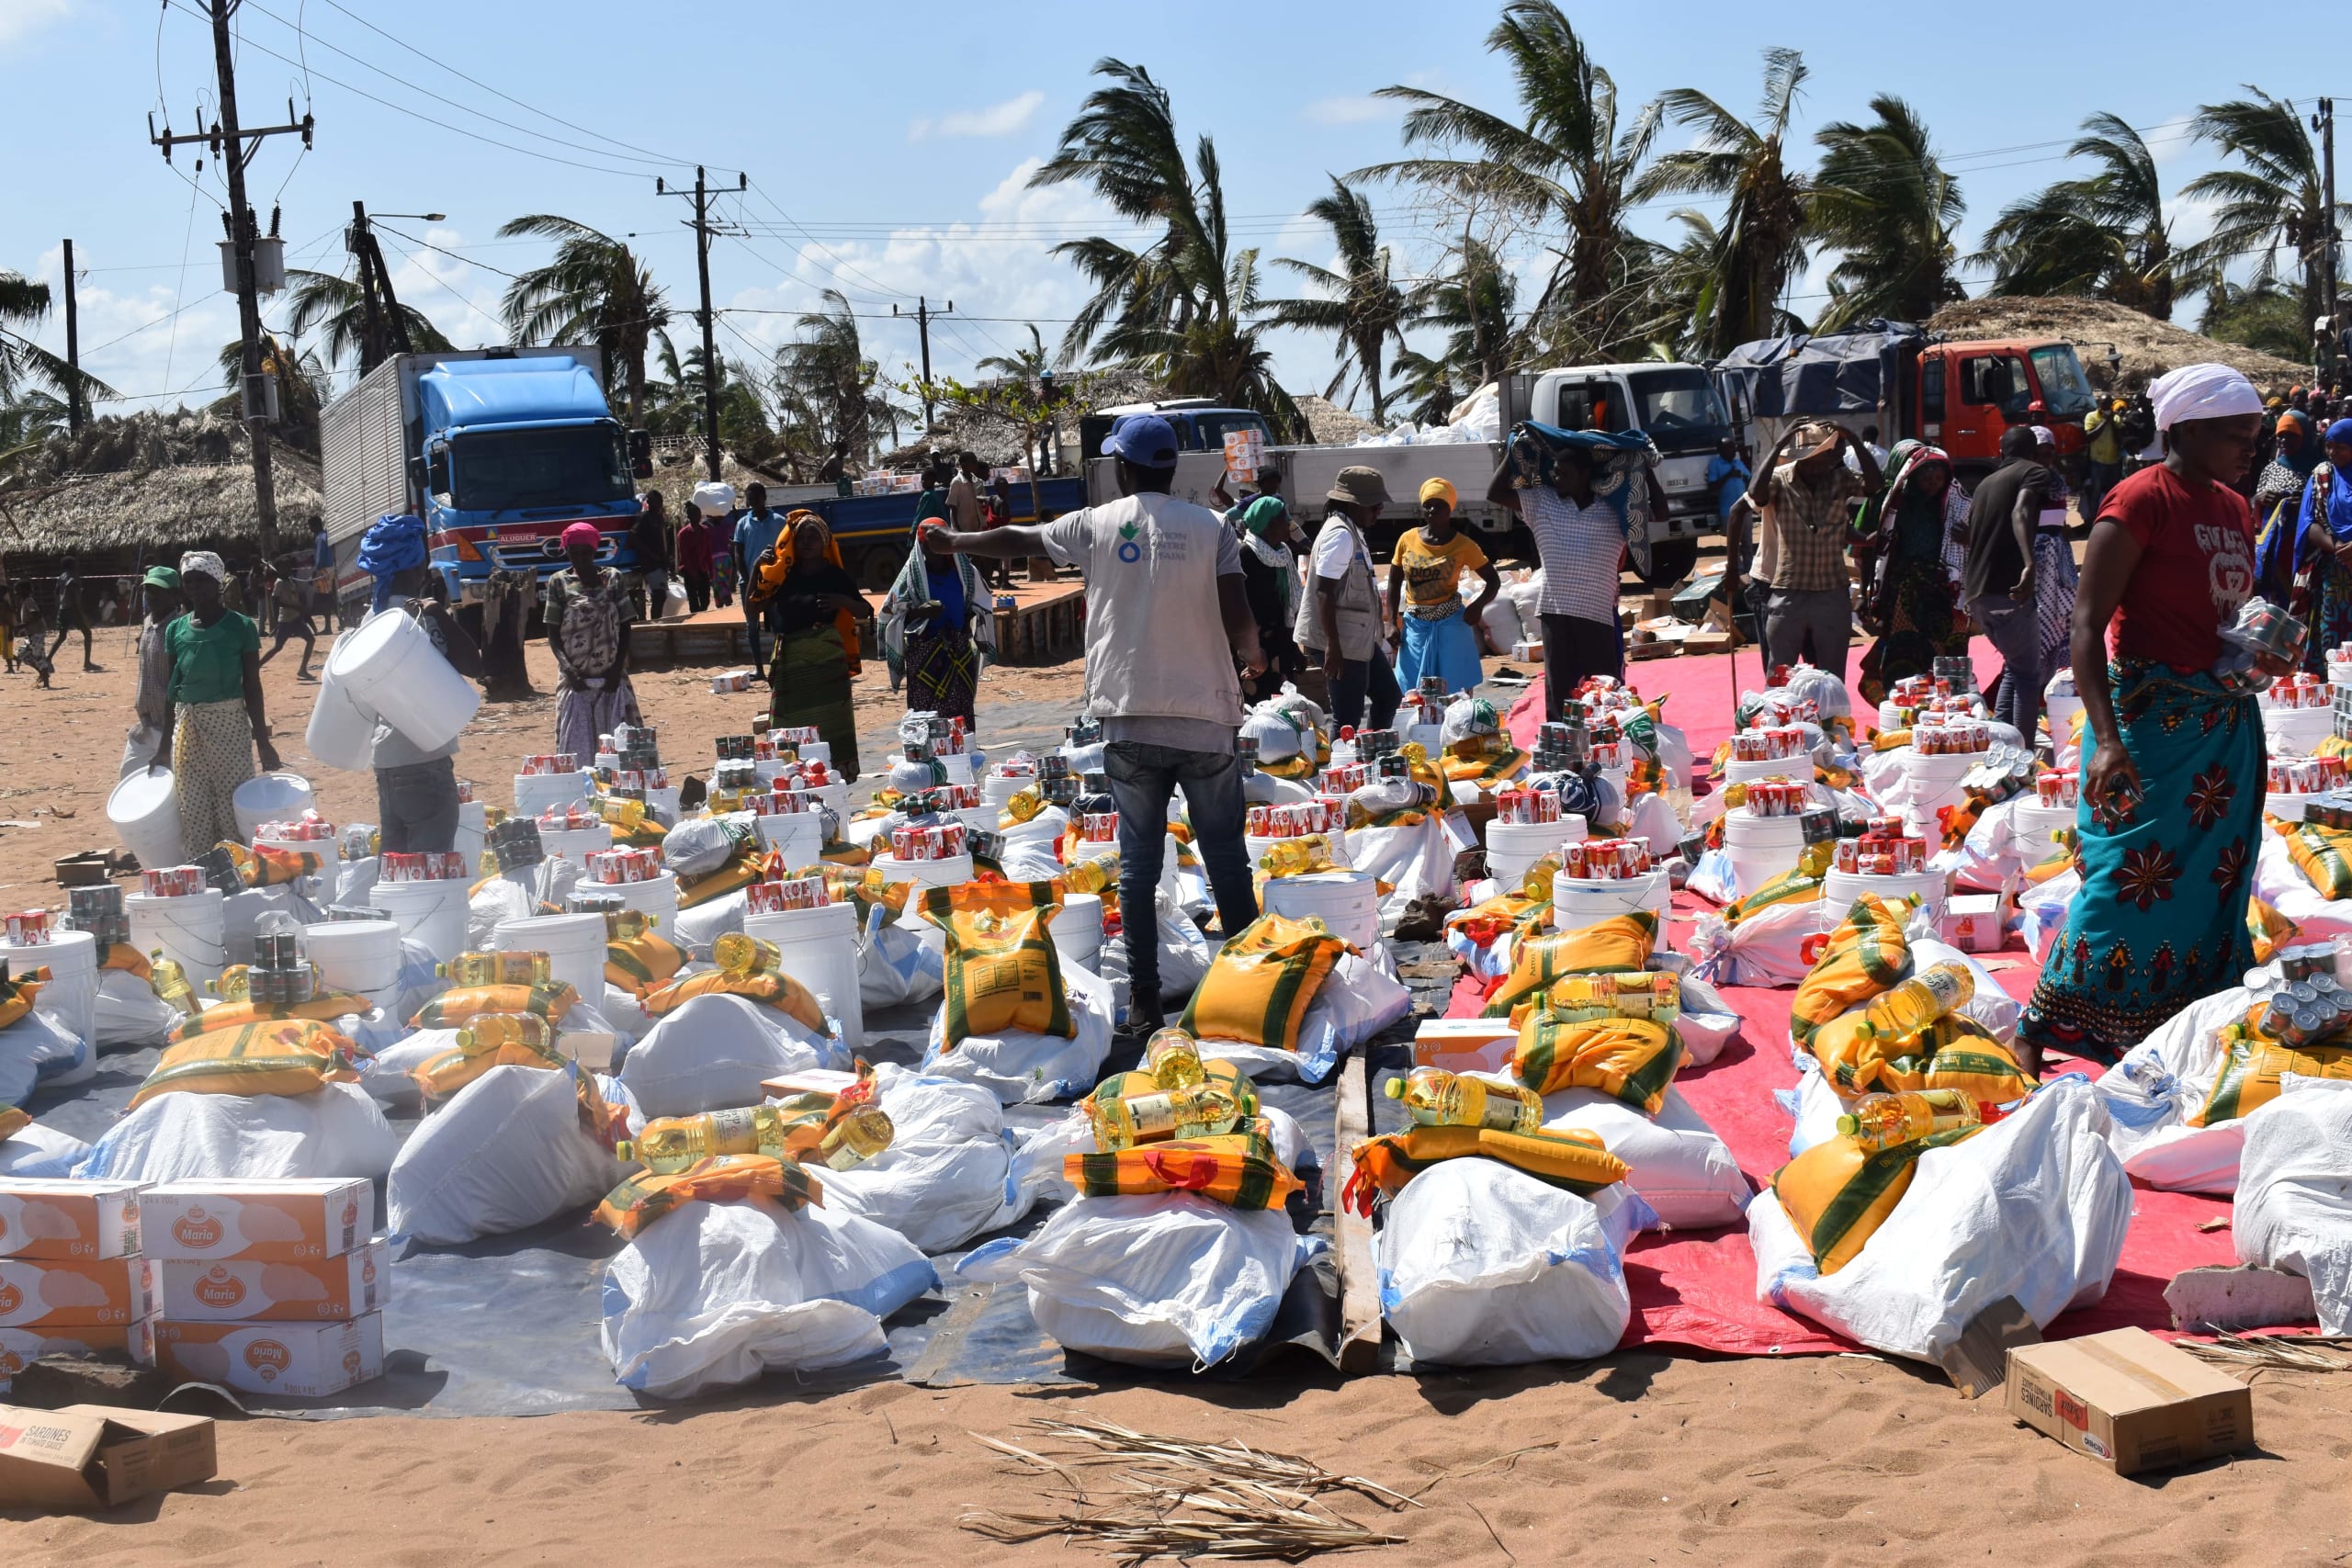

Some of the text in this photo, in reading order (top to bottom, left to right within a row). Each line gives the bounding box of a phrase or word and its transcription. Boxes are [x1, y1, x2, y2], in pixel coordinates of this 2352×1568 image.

[500, 535, 537, 543] ALUGUER
[1410, 567, 1441, 580] DIOR
[182, 1228, 213, 1240] Maria
[204, 1288, 236, 1300] Maria
[253, 1347, 282, 1359] Maria
[2021, 1387, 2052, 1418] SARDINES
[26, 1425, 72, 1442] SARDINES
[44, 1439, 65, 1451] SAUCE
